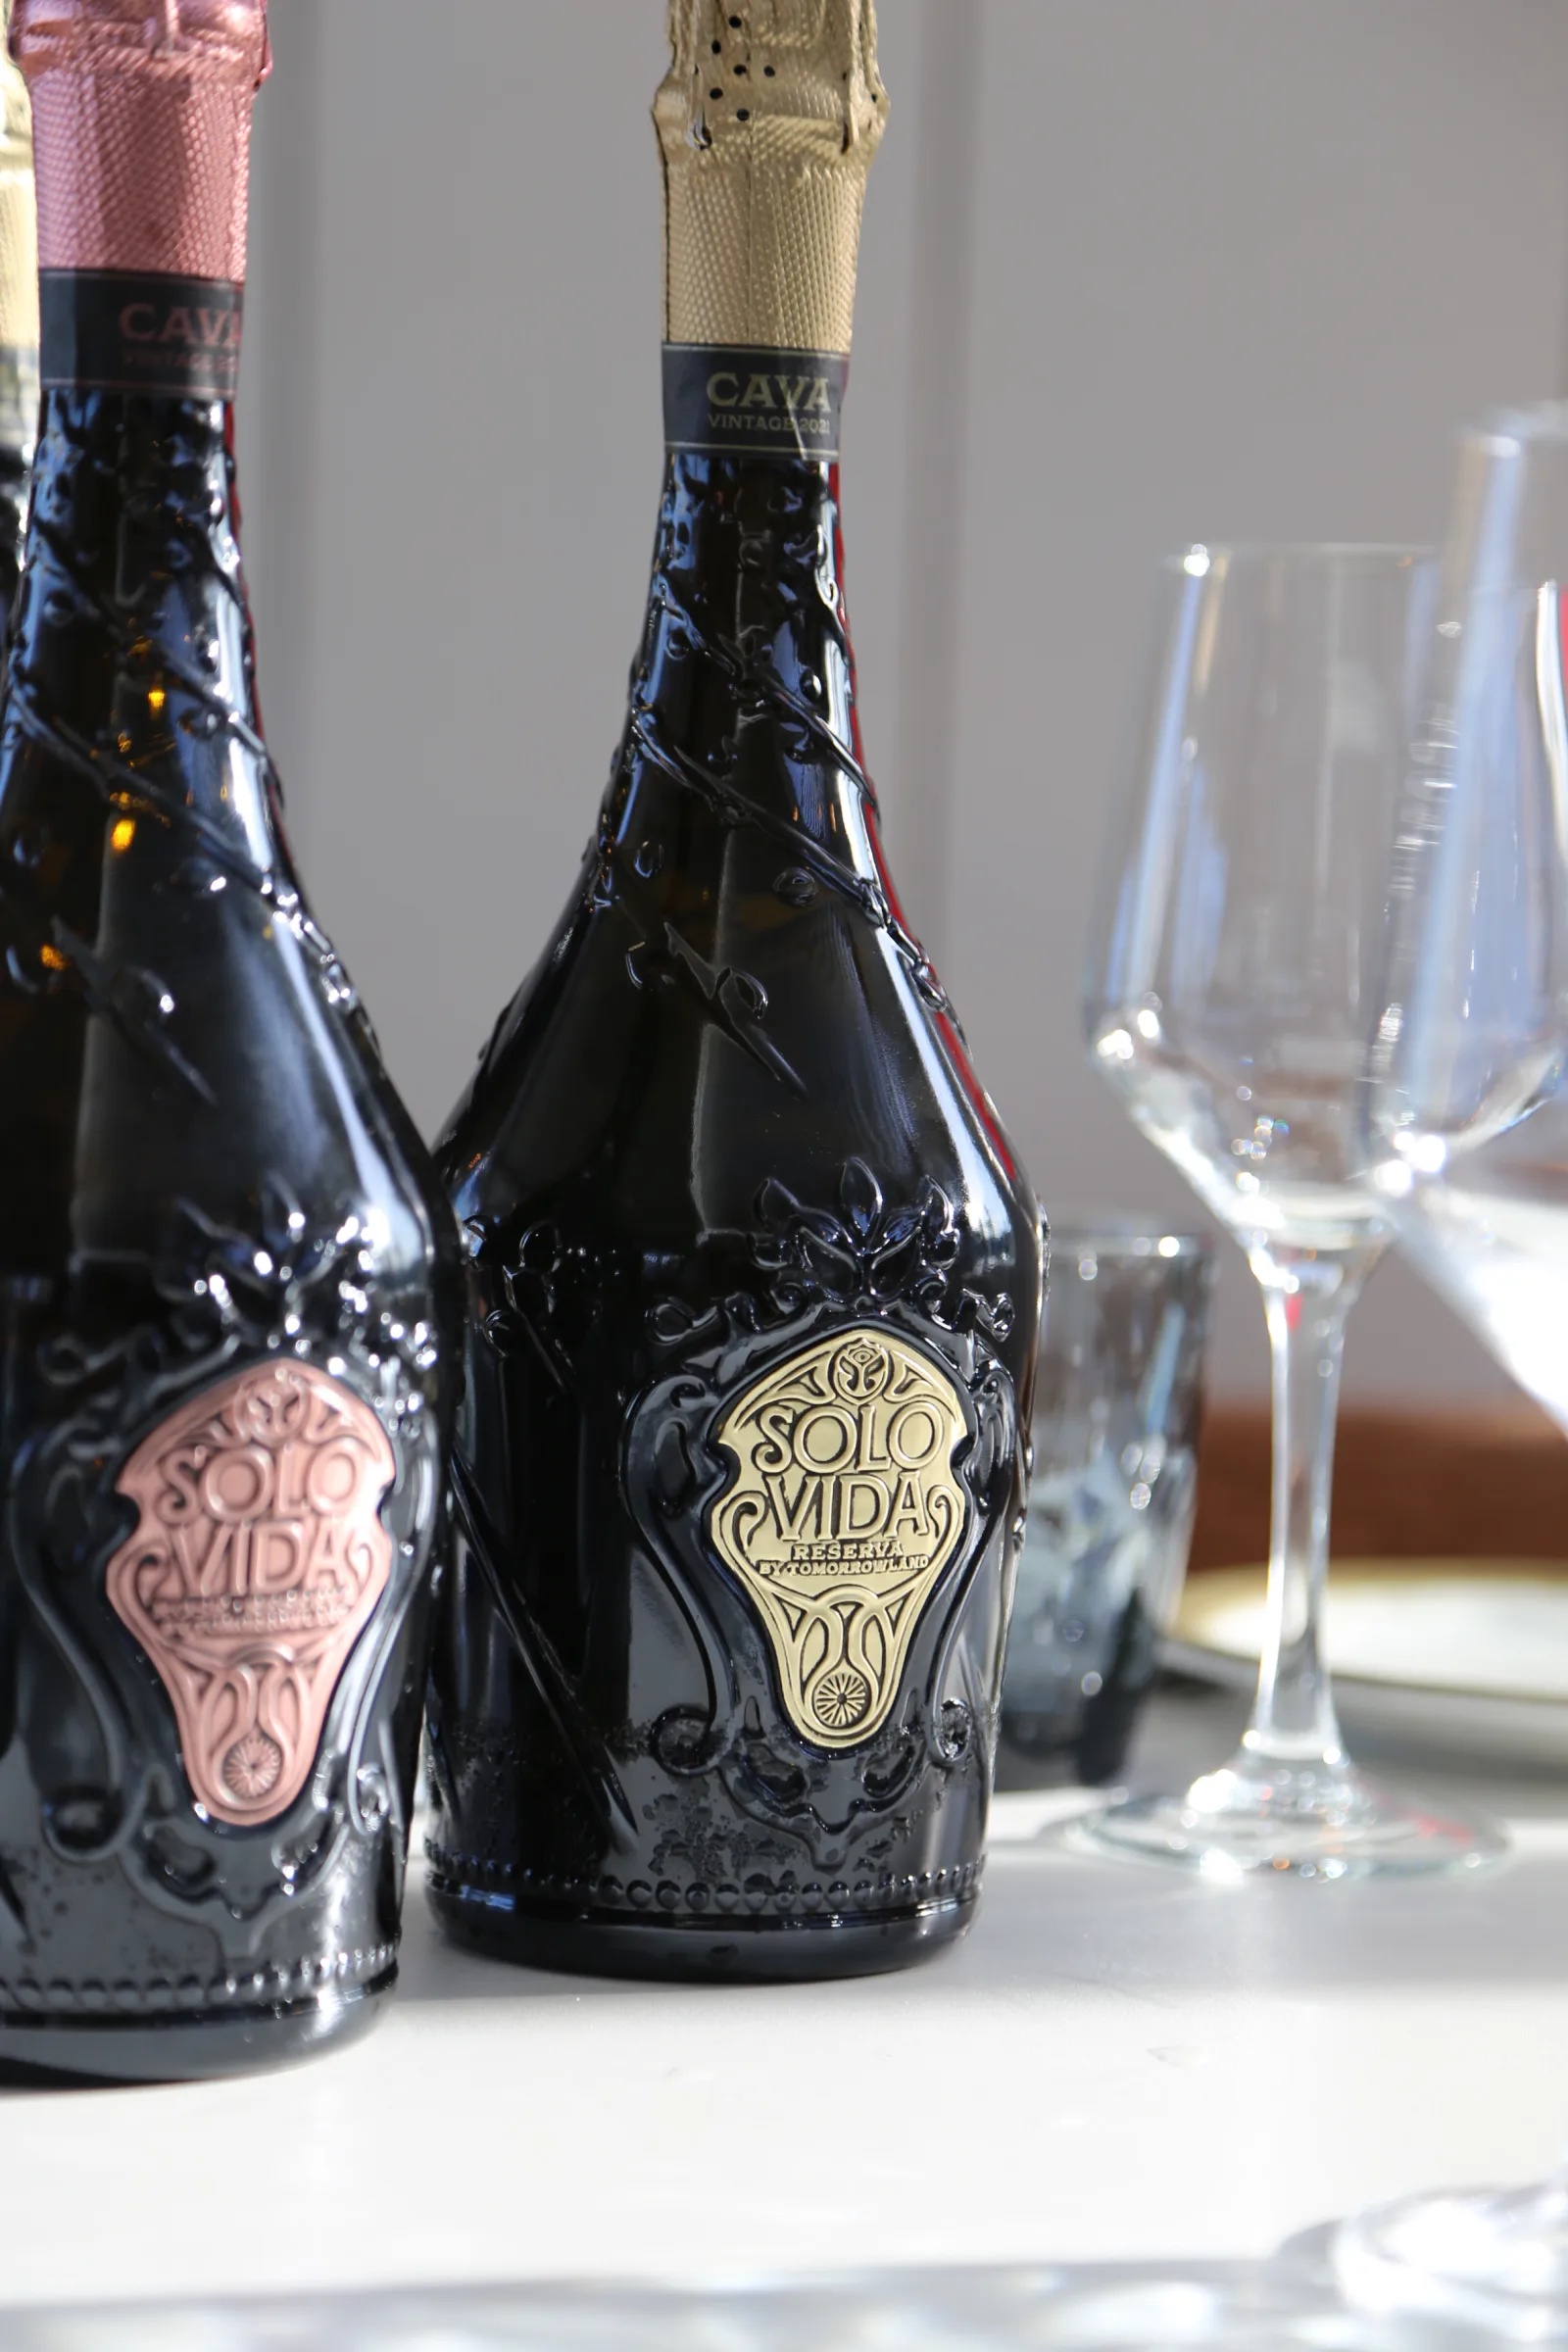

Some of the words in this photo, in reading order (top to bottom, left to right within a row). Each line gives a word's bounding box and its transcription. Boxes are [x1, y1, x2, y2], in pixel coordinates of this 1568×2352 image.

[707, 371, 831, 413] CAVA
[708, 413, 794, 431] VINTAGE
[752, 1404, 944, 1473] SOLO
[156, 1437, 360, 1524] SOLO
[763, 1470, 930, 1542] VIDA
[169, 1514, 350, 1595] VIDA
[759, 1561, 784, 1576] BY
[785, 1554, 930, 1576] TOMORROWLAND
[791, 1540, 904, 1560] RESERVA
